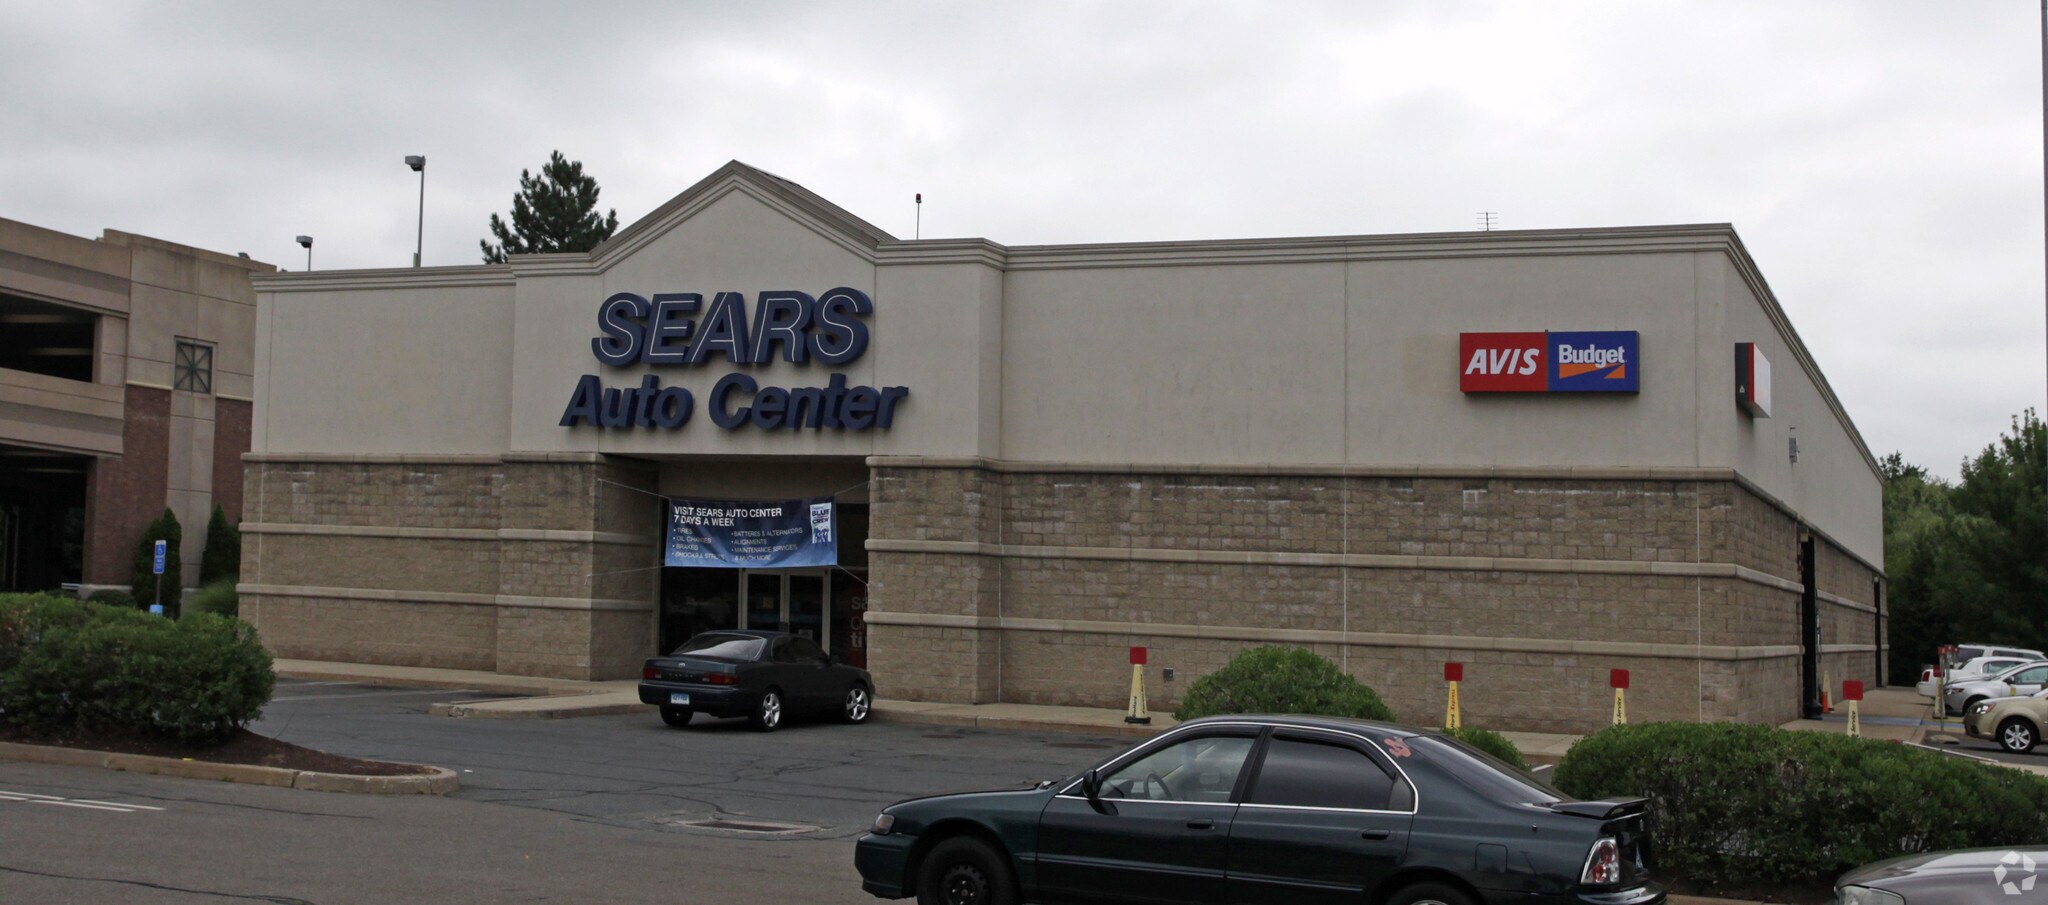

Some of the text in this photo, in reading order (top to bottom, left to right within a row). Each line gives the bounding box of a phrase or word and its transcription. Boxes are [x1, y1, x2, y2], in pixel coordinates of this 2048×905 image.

[591, 286, 873, 367] SEARS
[1465, 348, 1540, 376] AVIS
[1558, 344, 1625, 368] Budget
[558, 372, 909, 430] Auto Center
[674, 506, 782, 518] VISIT SEARS AUTO CENTER
[812, 508, 830, 517] BLUE
[673, 515, 735, 527] 7 DAYS A WEEK
[676, 527, 693, 535] TIRES
[675, 543, 699, 551] BRAKES
